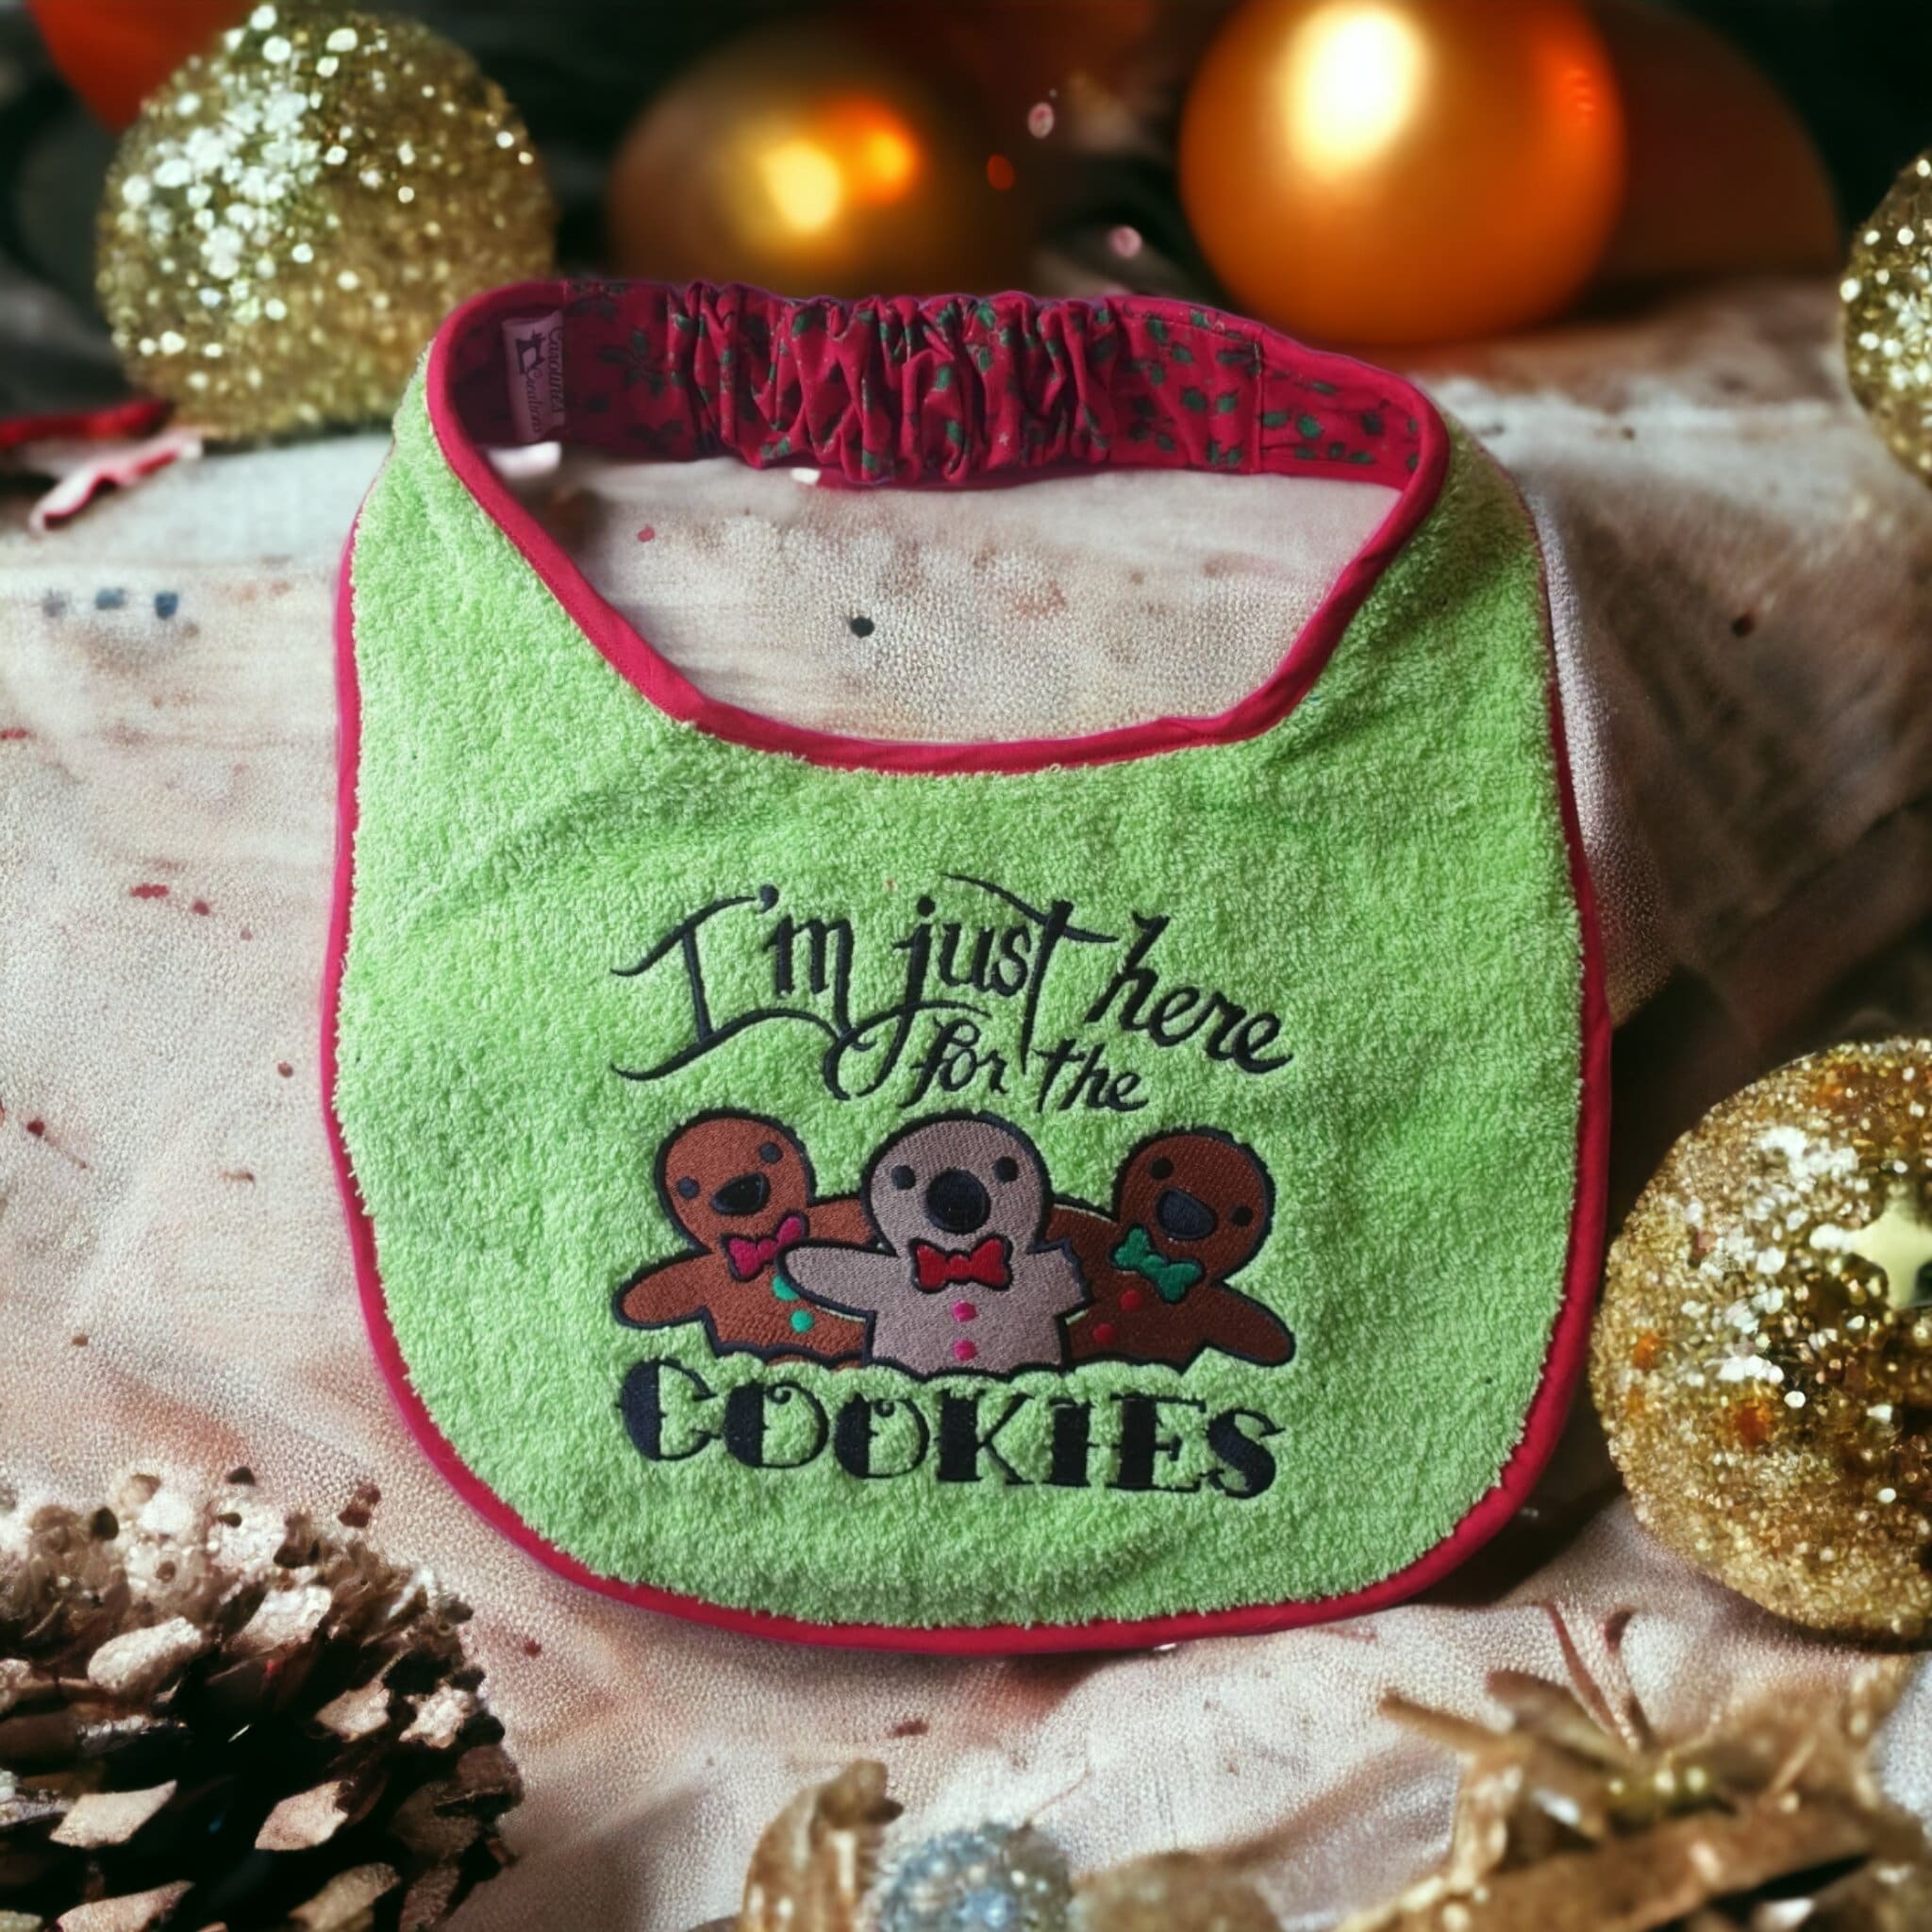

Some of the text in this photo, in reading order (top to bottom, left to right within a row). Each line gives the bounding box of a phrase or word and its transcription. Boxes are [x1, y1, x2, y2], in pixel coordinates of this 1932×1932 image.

[611, 873, 1292, 1101] I'm just here
[898, 1019, 1150, 1113] for the
[615, 1357, 1287, 1500] COOKIES
